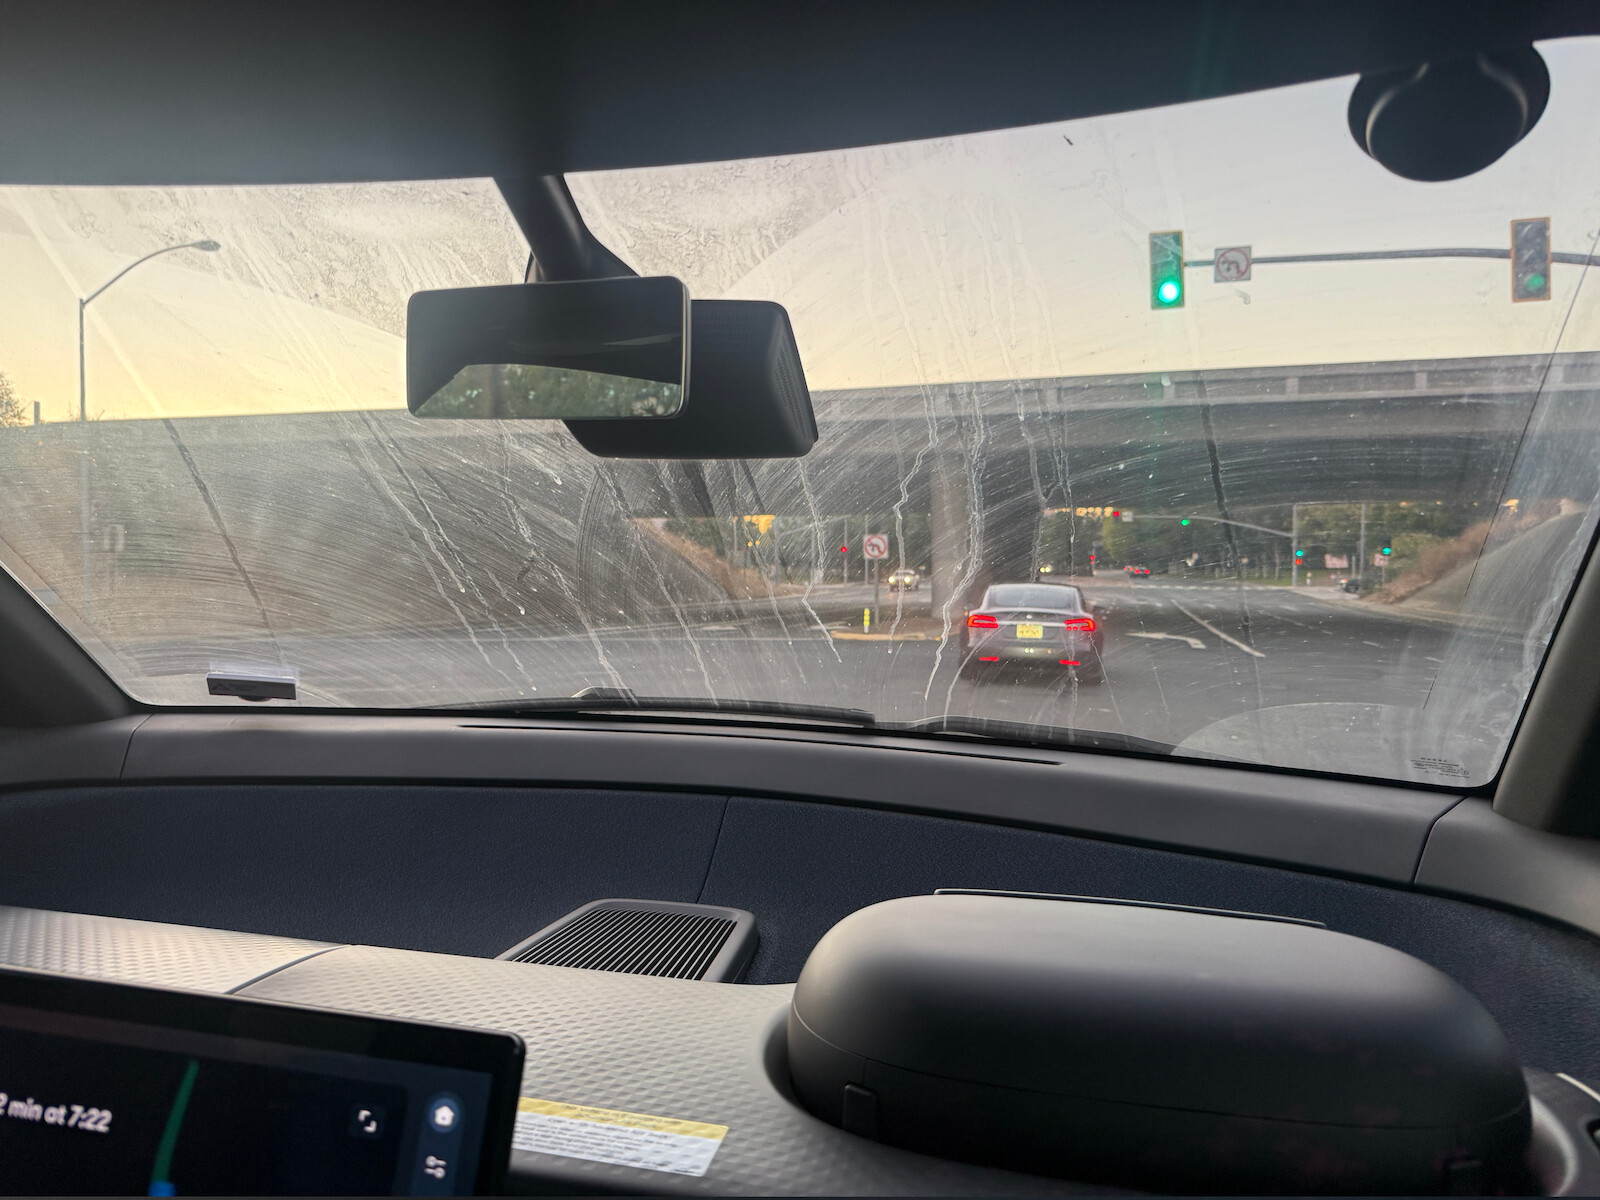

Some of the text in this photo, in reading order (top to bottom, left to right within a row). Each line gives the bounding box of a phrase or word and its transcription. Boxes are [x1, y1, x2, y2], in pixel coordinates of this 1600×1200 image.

[8, 1097, 43, 1121] min
[44, 1105, 67, 1125] at
[67, 1104, 112, 1133] 7:22
